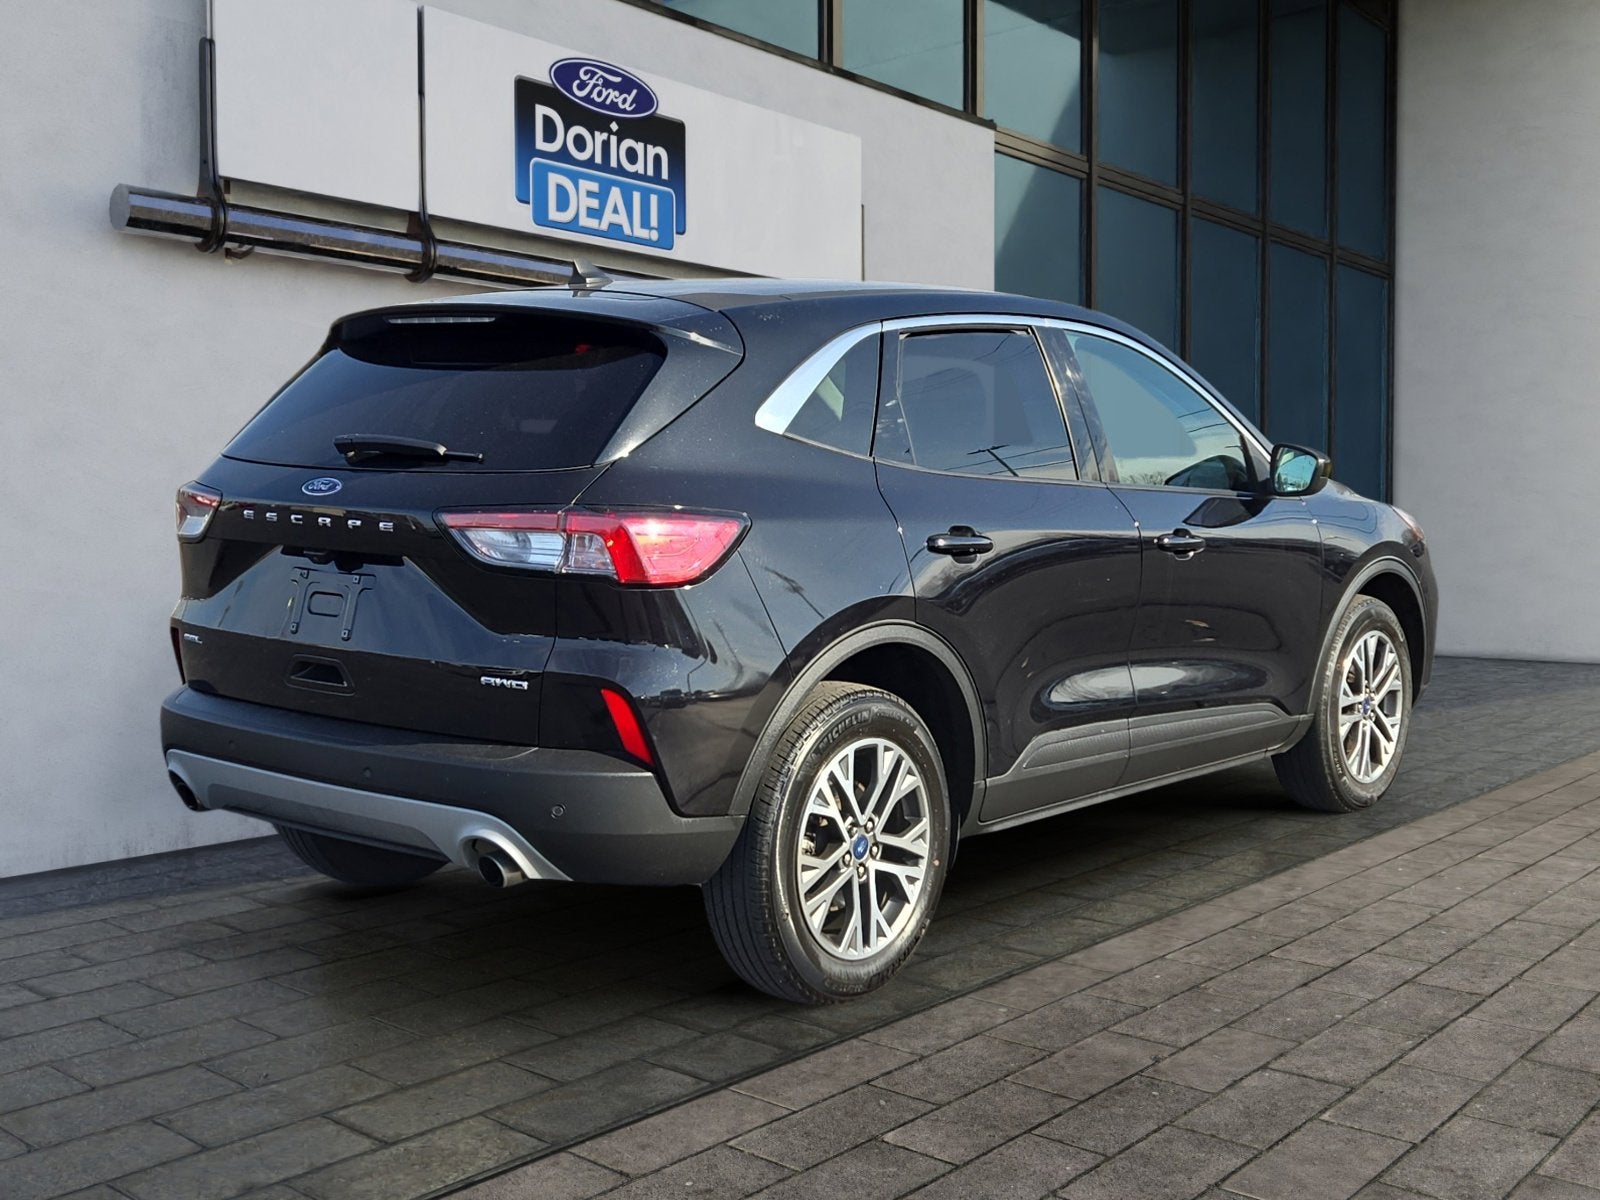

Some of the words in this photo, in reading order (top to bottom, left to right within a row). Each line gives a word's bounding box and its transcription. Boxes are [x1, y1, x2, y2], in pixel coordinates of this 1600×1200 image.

[572, 66, 637, 112] Ford
[534, 103, 669, 180] Dorian
[547, 171, 659, 242] DEAL!
[243, 509, 394, 532] ESCAPE
[819, 710, 870, 751] MICHELIN
